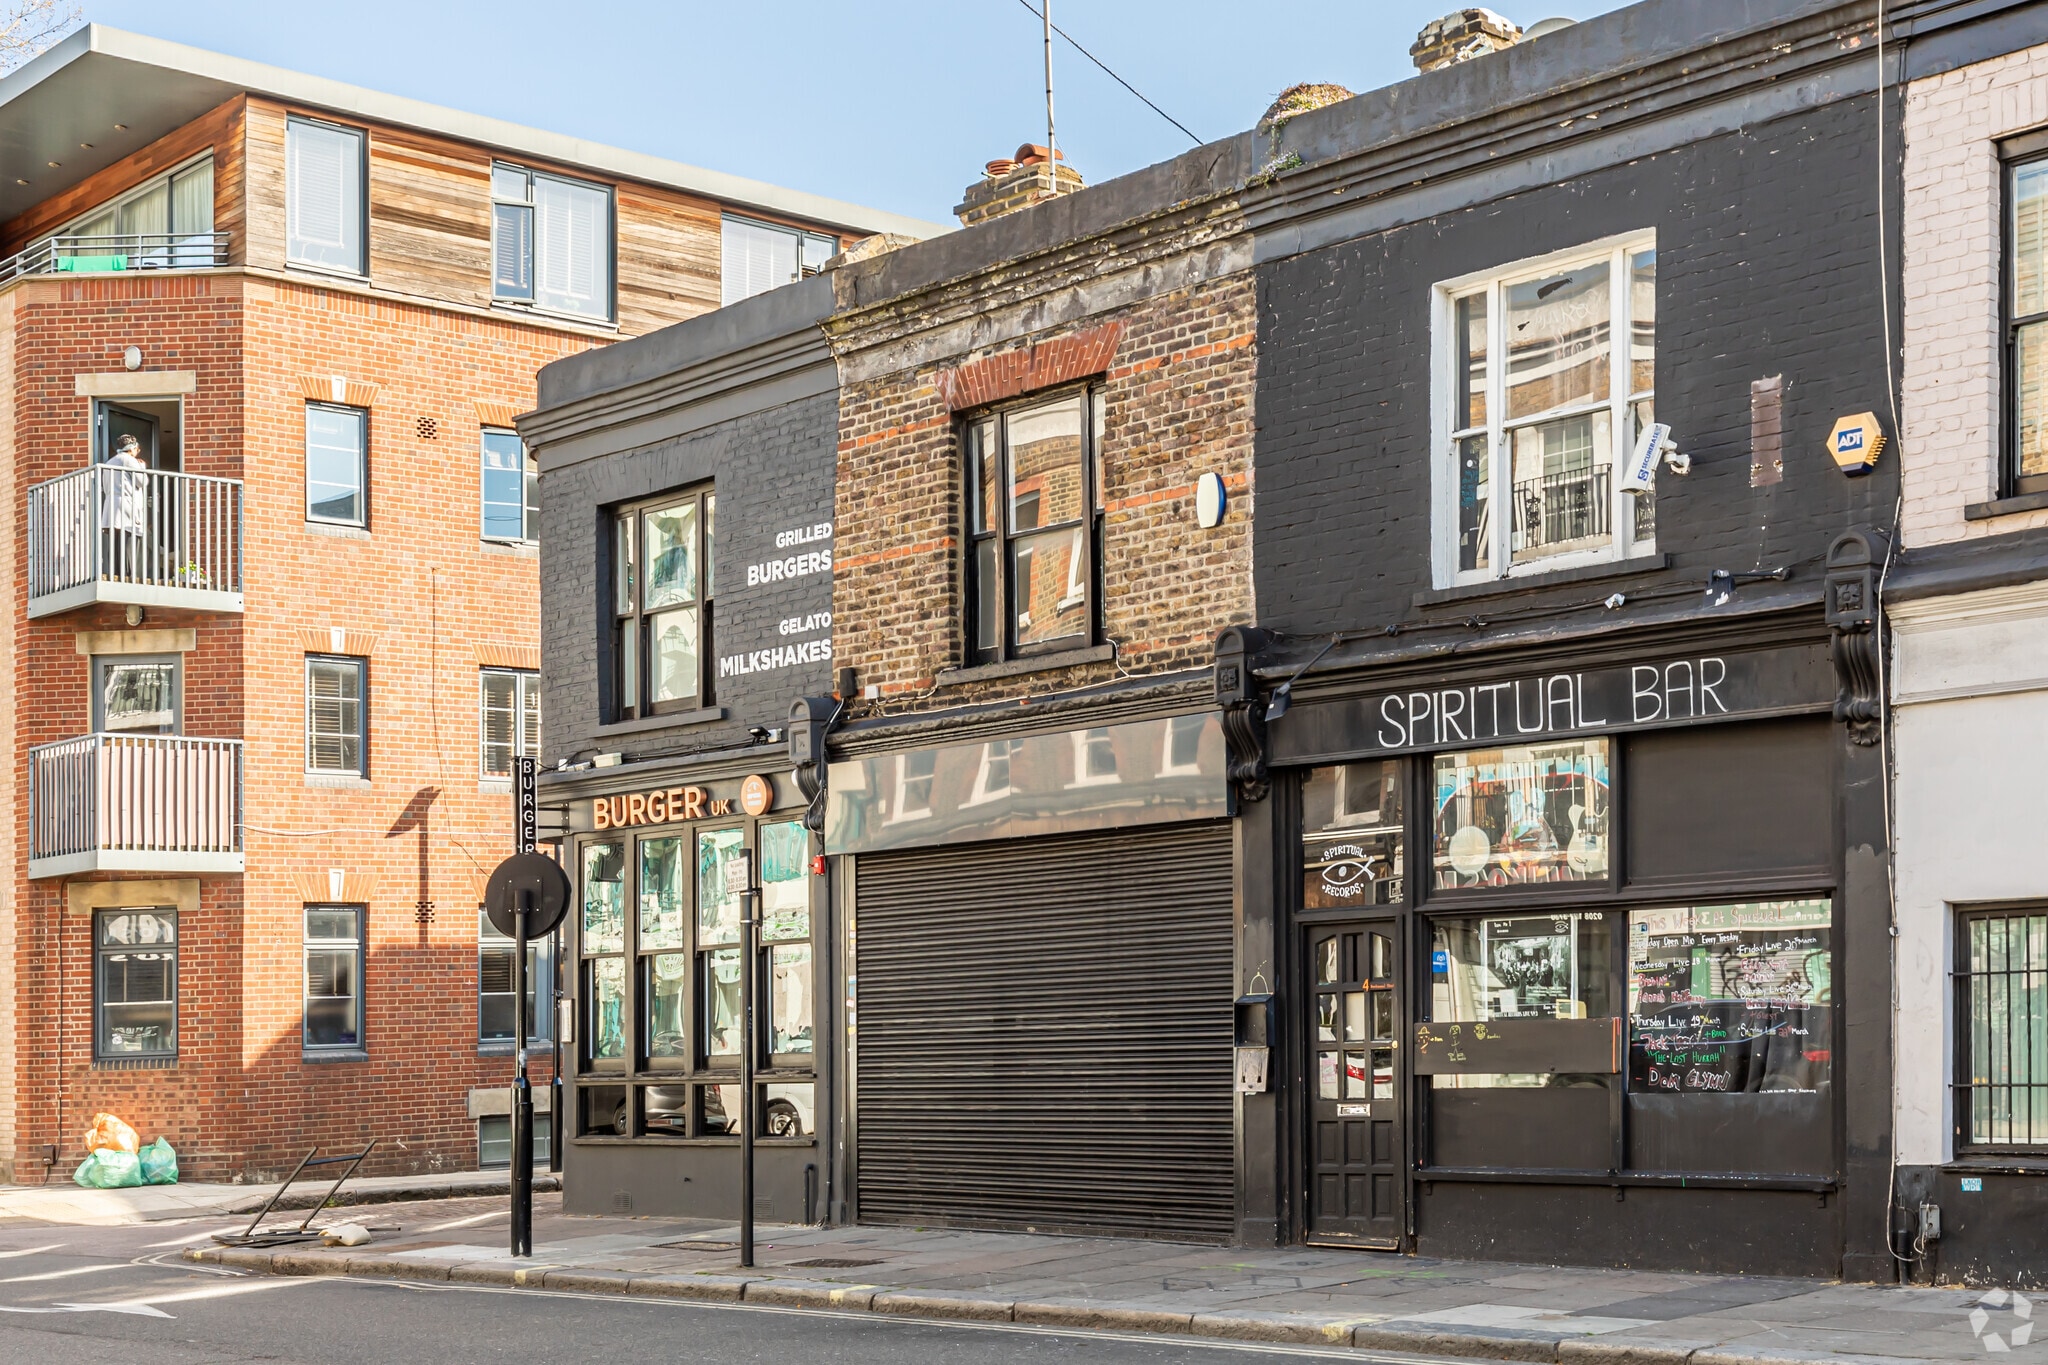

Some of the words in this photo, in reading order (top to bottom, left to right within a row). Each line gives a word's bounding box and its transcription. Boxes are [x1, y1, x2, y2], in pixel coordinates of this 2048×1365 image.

[1838, 431, 1863, 449] ADT
[775, 522, 833, 548] GRILLED
[747, 549, 832, 586] BURGERS
[778, 611, 832, 636] GELATO
[720, 638, 832, 678] MILKSHAKES
[1377, 672, 1607, 749] SPIRITUAL
[1630, 656, 1729, 724] BAR
[523, 760, 536, 853] BURGER
[593, 785, 705, 830] BURGER
[710, 798, 731, 816] UK
[1323, 844, 1364, 861] SPIRITUAL
[1324, 882, 1361, 898] RECORDS
[1738, 943, 1764, 955] Friday
[1765, 941, 1783, 951] Live
[1632, 961, 1668, 971] Wednesday
[1673, 957, 1690, 967] Live
[1633, 1014, 1665, 1029] Thursday
[1668, 1014, 1686, 1027] Live
[1791, 1027, 1809, 1036] March
